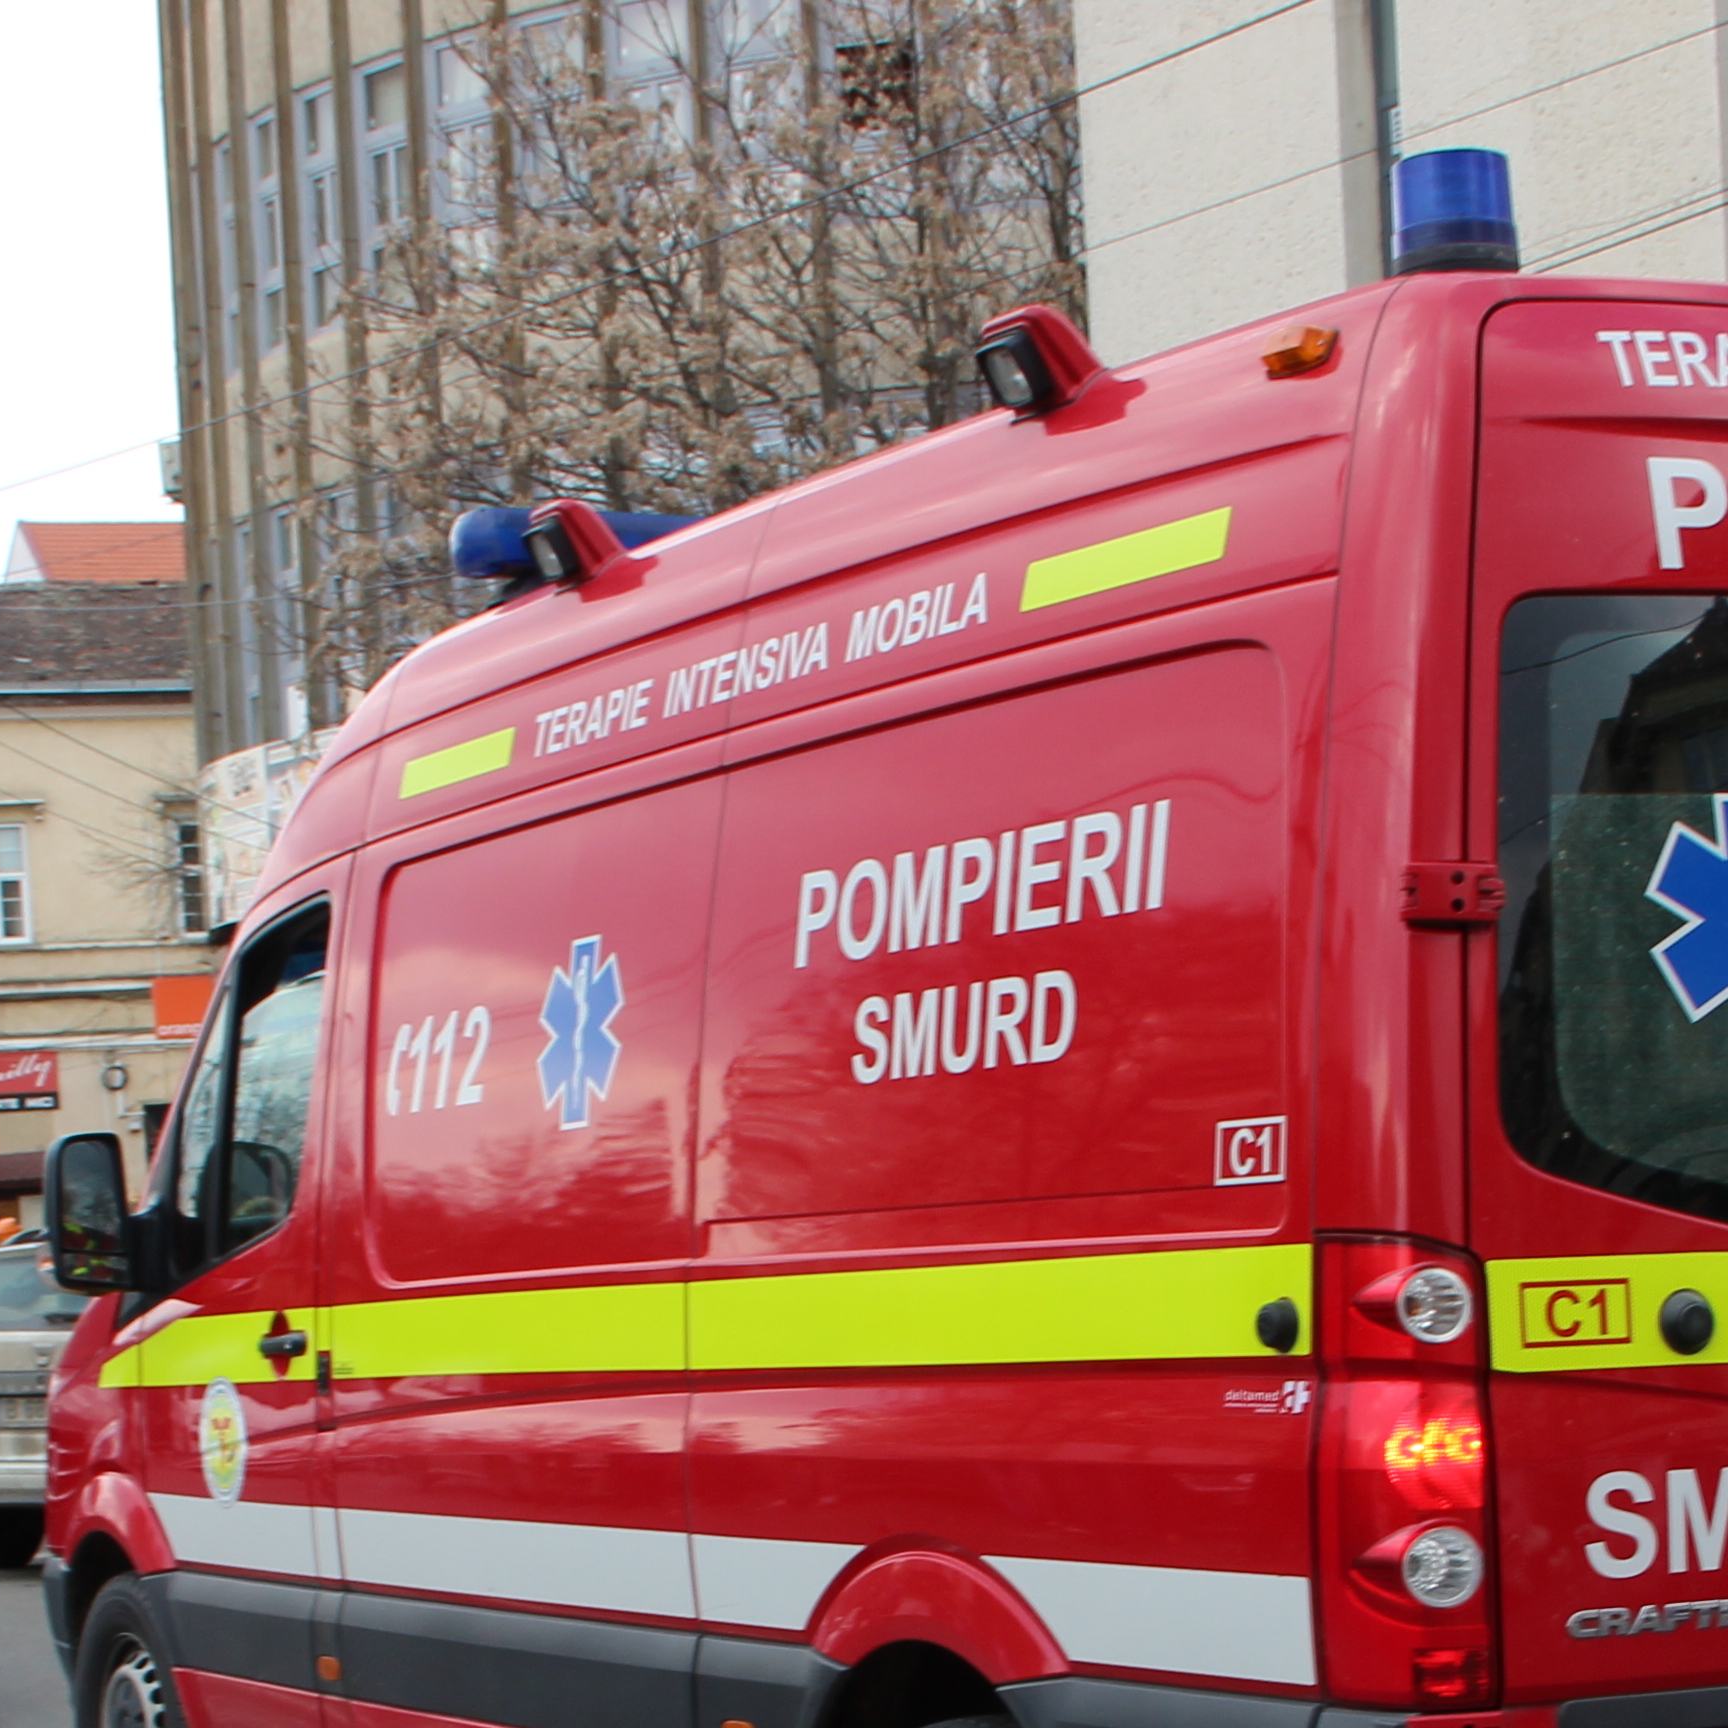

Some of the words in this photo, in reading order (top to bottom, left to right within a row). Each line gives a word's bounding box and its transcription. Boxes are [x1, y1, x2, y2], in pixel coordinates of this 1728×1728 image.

[533, 677, 655, 758] TERAPIE
[662, 622, 830, 719] INTENSIVA
[844, 571, 989, 664] MOBILA
[793, 798, 1172, 969] POMPIERII
[850, 969, 1078, 1085] SMURD
[1228, 1124, 1274, 1177] C1
[1544, 1288, 1610, 1338] C1
